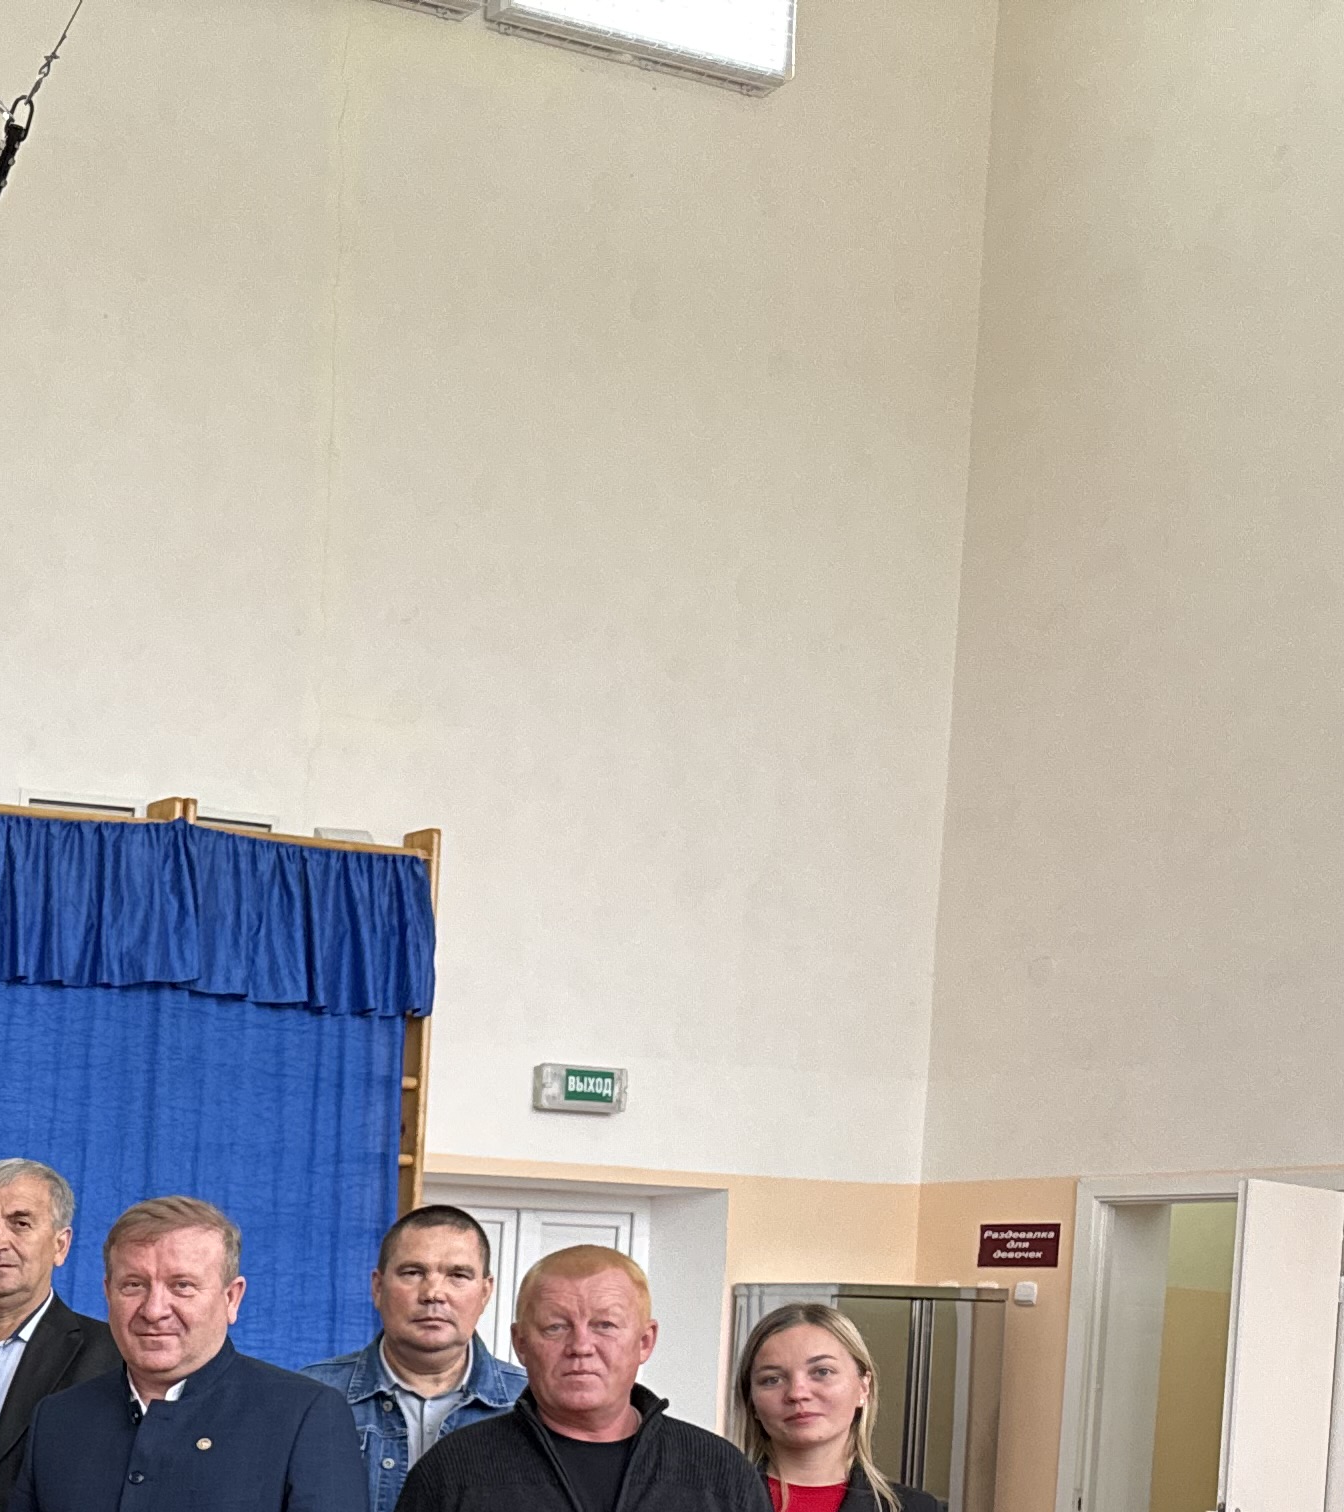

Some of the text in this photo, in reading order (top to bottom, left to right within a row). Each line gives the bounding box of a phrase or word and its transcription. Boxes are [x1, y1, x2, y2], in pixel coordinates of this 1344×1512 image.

[567, 1076, 612, 1097] ВЫХОД
[983, 1229, 1056, 1240] Раздевалка
[1006, 1239, 1030, 1249] для
[992, 1249, 1044, 1259] девочек
